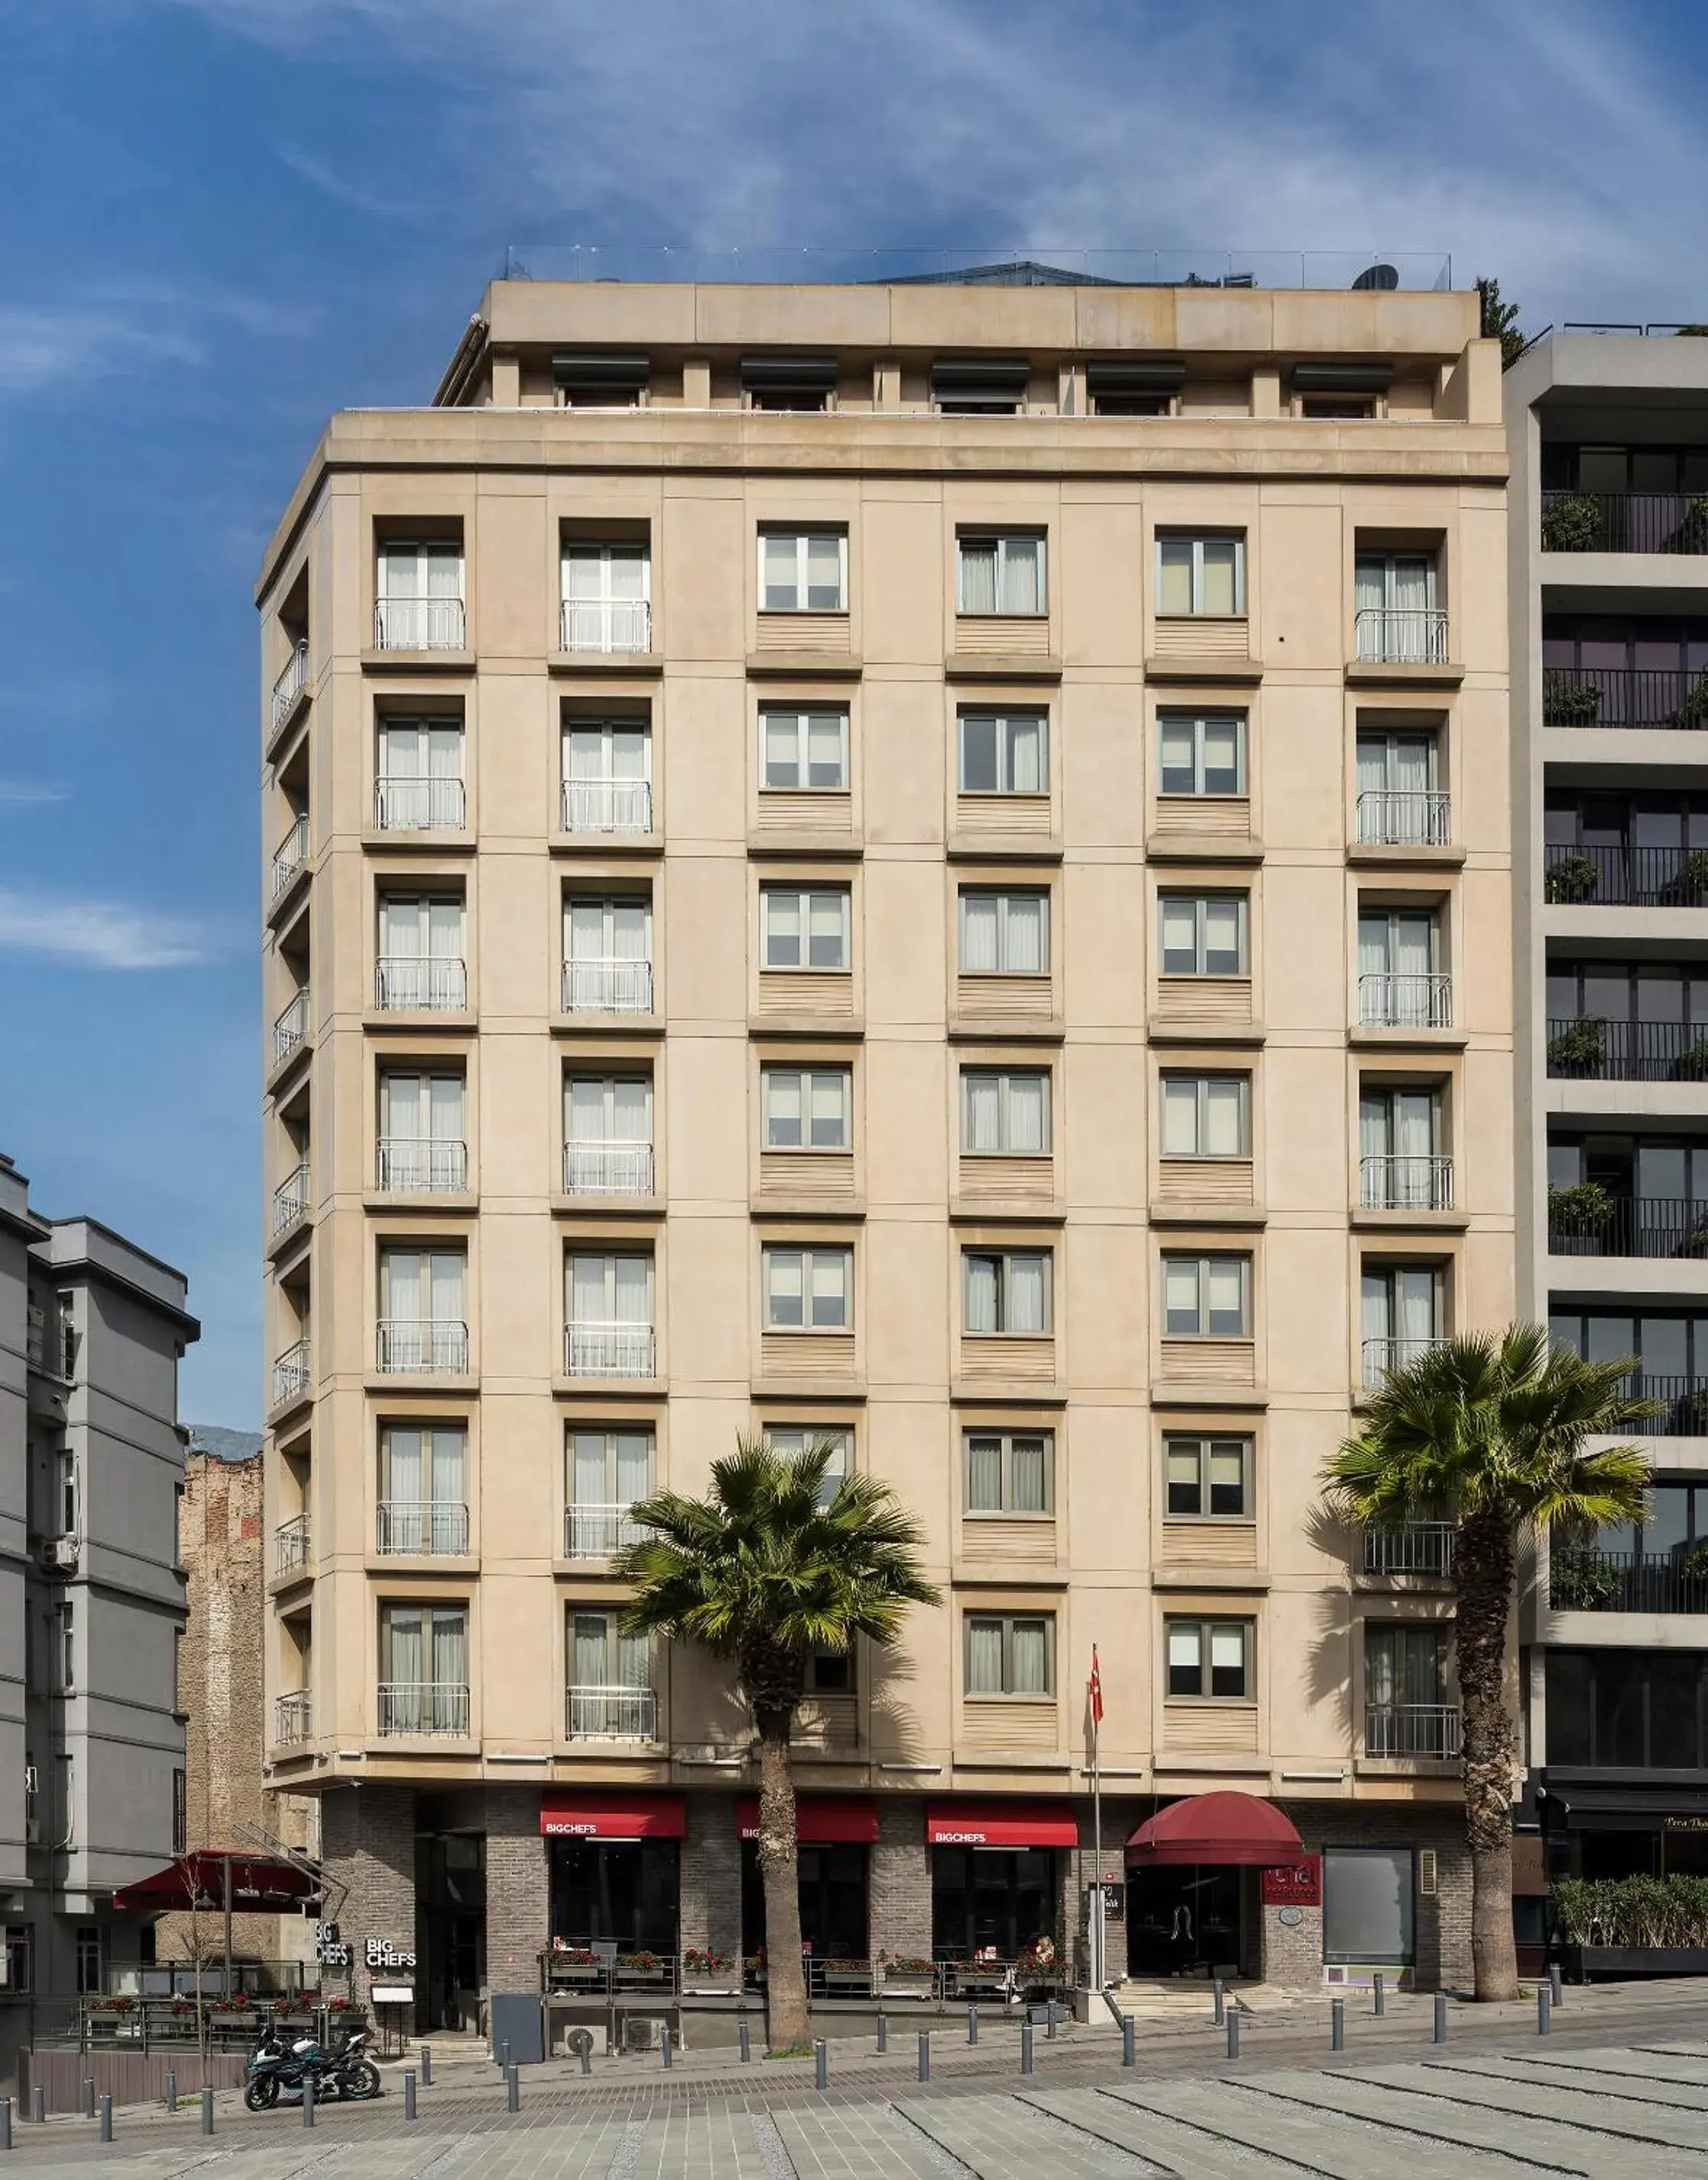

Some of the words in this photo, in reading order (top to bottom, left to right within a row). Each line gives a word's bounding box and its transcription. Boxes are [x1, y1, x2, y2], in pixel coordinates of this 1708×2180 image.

[546, 1823, 597, 1833] BIGCHEFS
[935, 1832, 987, 1842] BIGCHEFS
[367, 1939, 394, 1953] BIG
[315, 1943, 348, 1966] CHEFS
[367, 1953, 416, 1966] CHEFS
